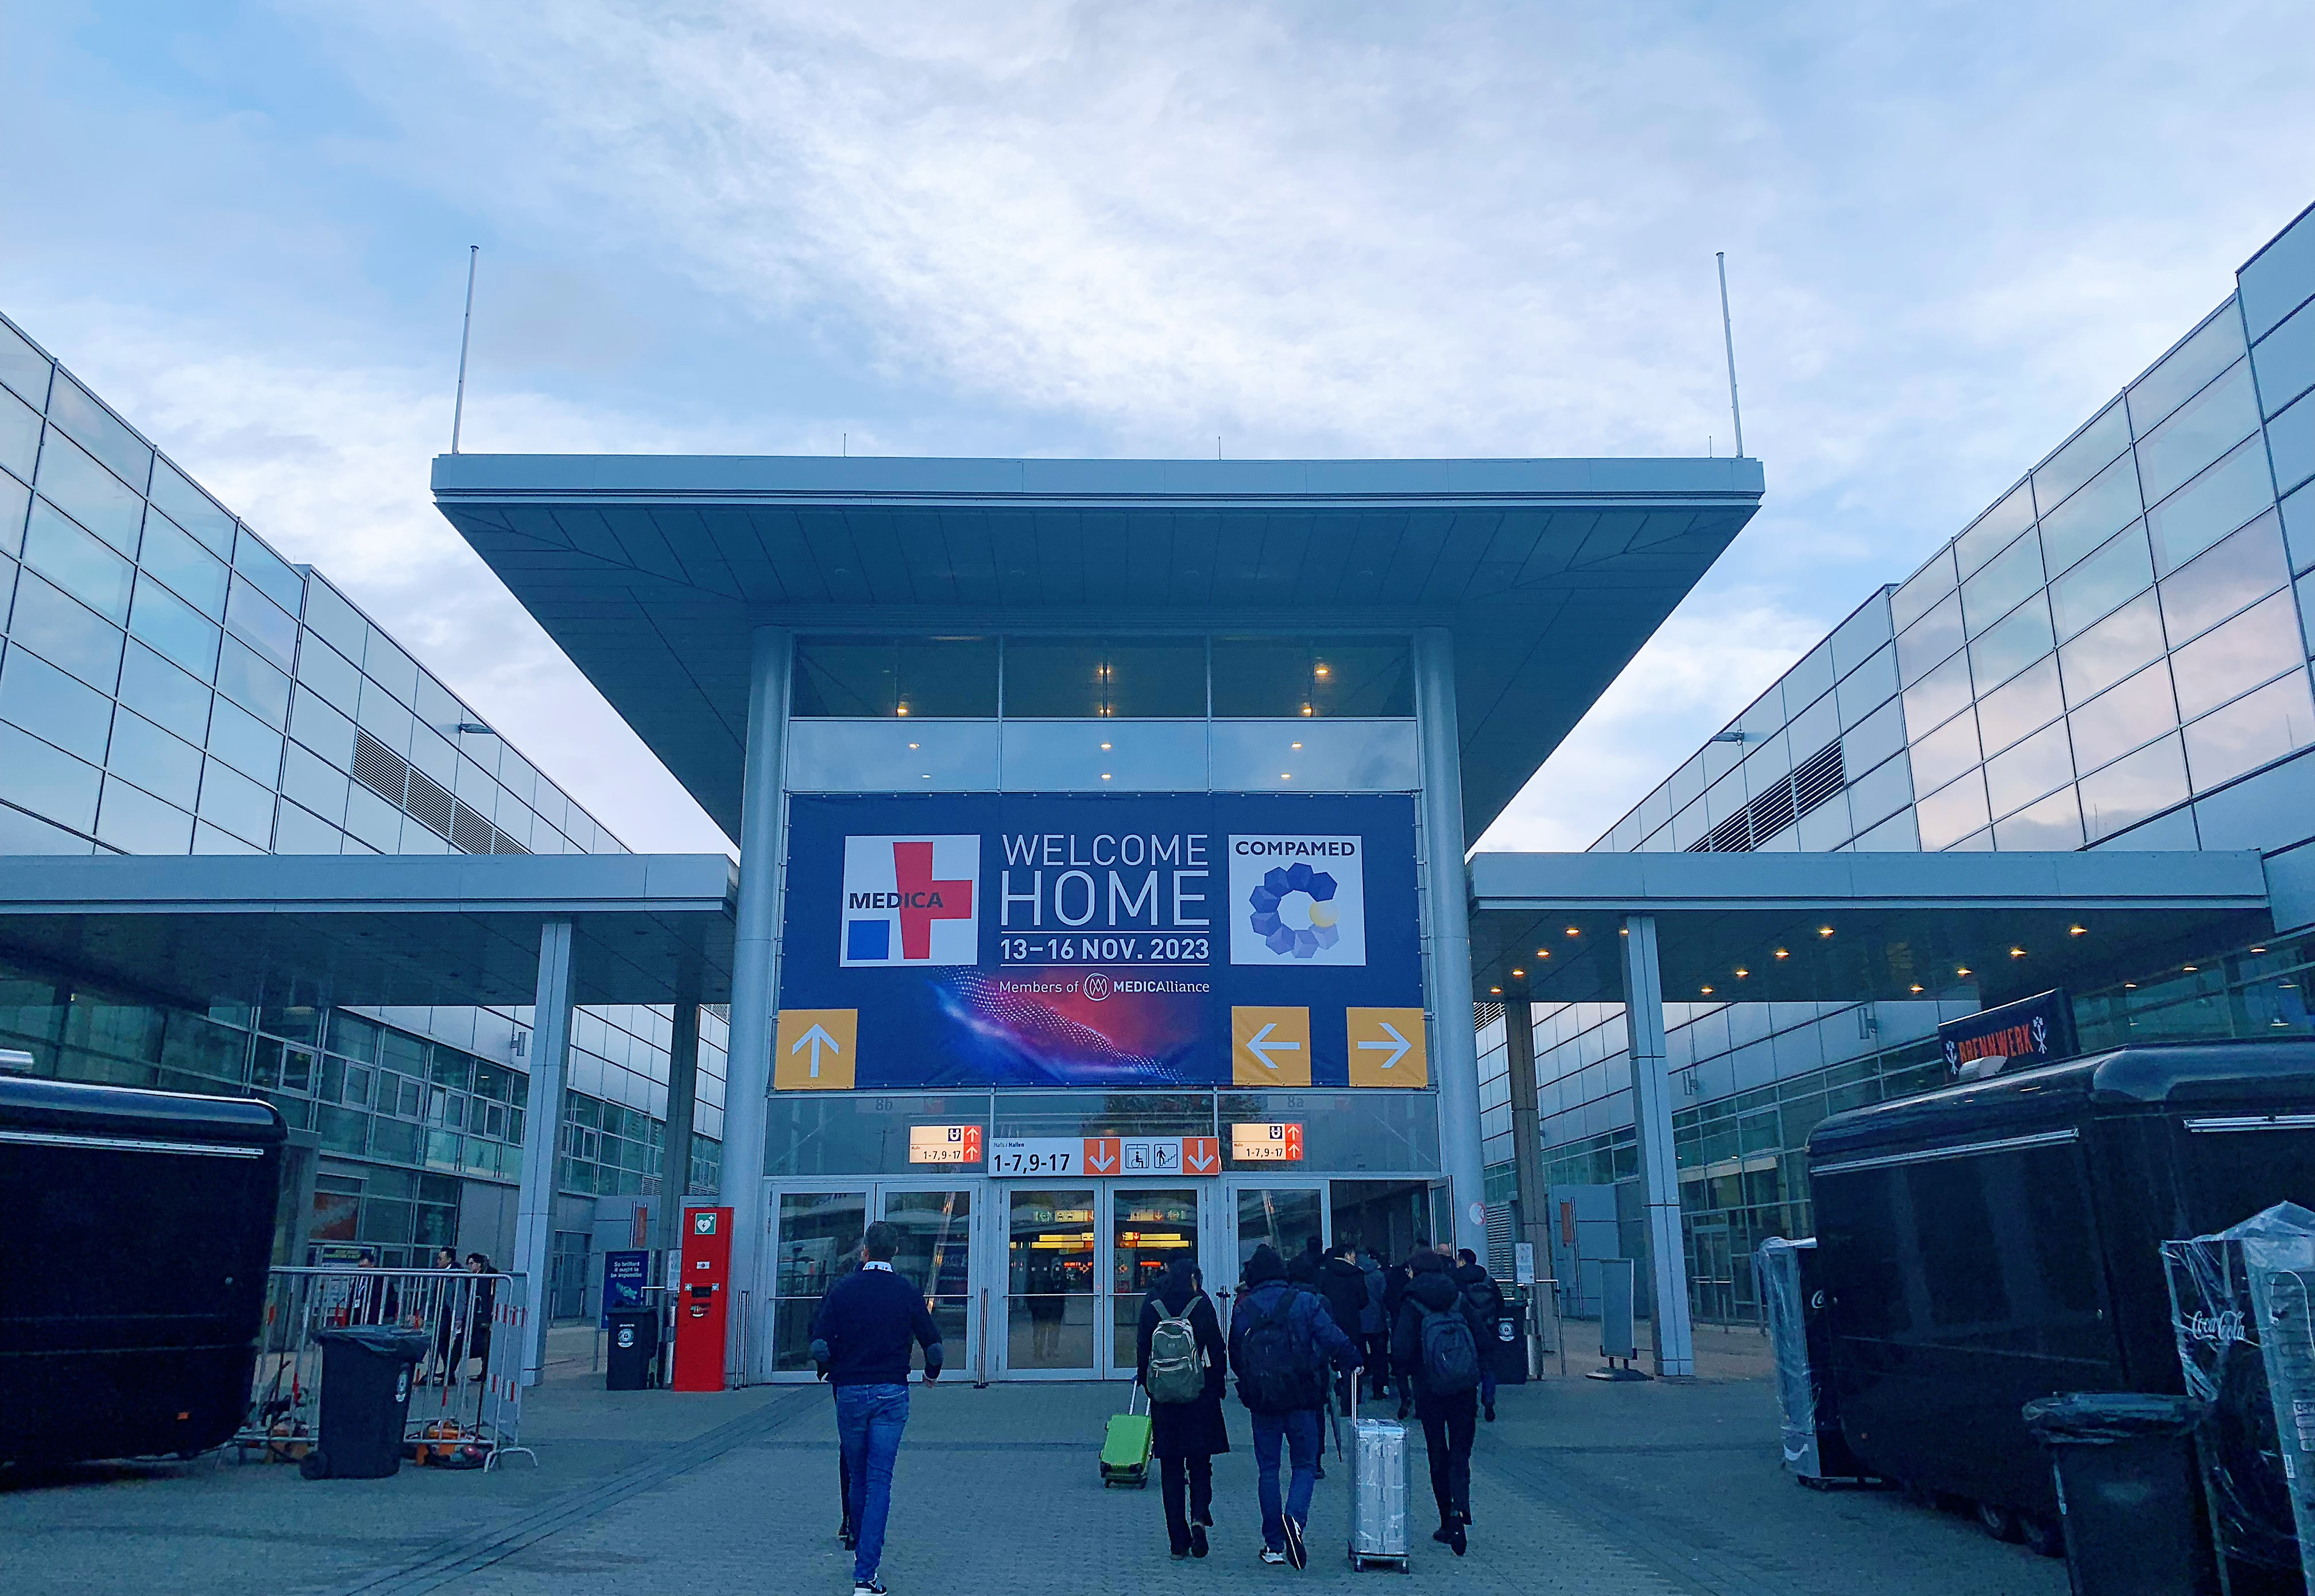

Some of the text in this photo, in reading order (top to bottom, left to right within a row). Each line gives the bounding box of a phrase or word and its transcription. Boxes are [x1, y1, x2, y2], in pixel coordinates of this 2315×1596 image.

[1002, 834, 1208, 866] WELCOME
[1236, 841, 1355, 856] COMPAMED
[849, 892, 943, 909] MEDICA
[1001, 870, 1210, 926] HOME
[1082, 939, 1143, 959] NOV.
[1151, 939, 1209, 959] 2023
[999, 981, 1210, 993] Members of MEDICAlliance
[1958, 1024, 2034, 1064] BRENNWERK
[876, 1098, 892, 1111] 8b
[1288, 1095, 1304, 1107] 8a
[994, 1153, 1070, 1174] 1-7,9-17
